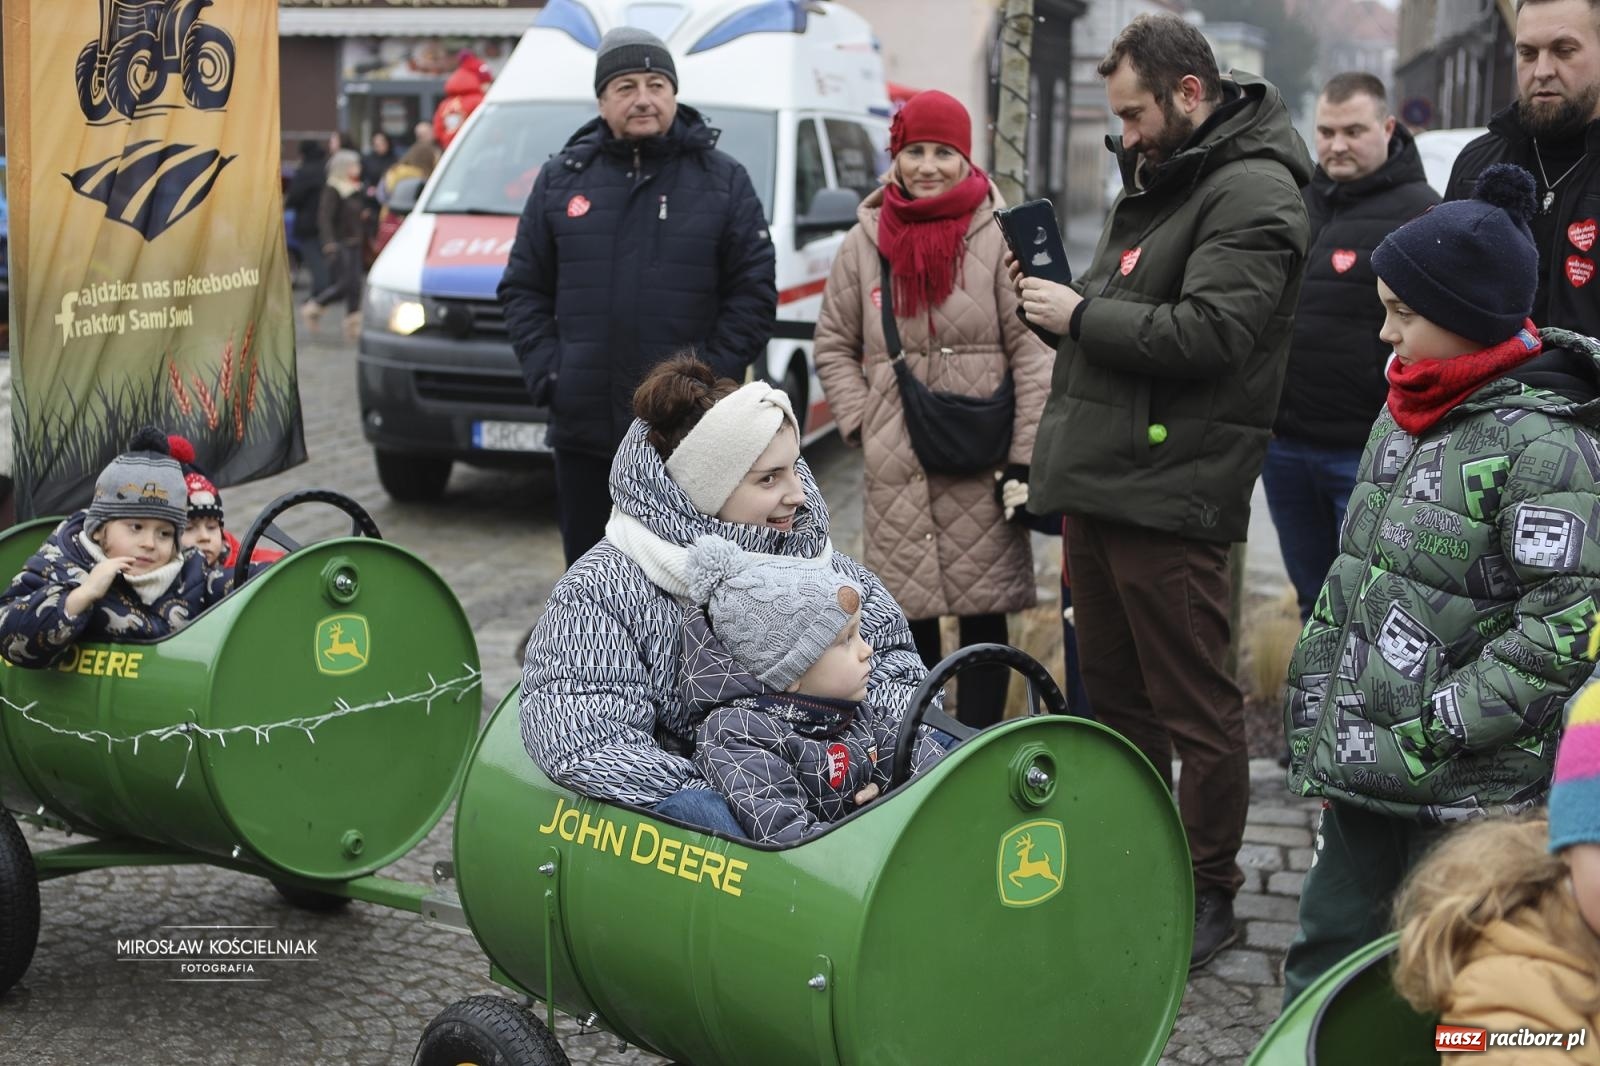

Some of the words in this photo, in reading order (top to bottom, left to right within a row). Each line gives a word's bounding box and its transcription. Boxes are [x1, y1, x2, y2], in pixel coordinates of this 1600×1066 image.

[142, 280, 171, 299] nas
[128, 306, 168, 331] Sami
[169, 304, 194, 328] Swoi
[1414, 531, 1469, 561] CREATE
[539, 798, 627, 857] JOHN
[630, 822, 749, 897] DEERE
